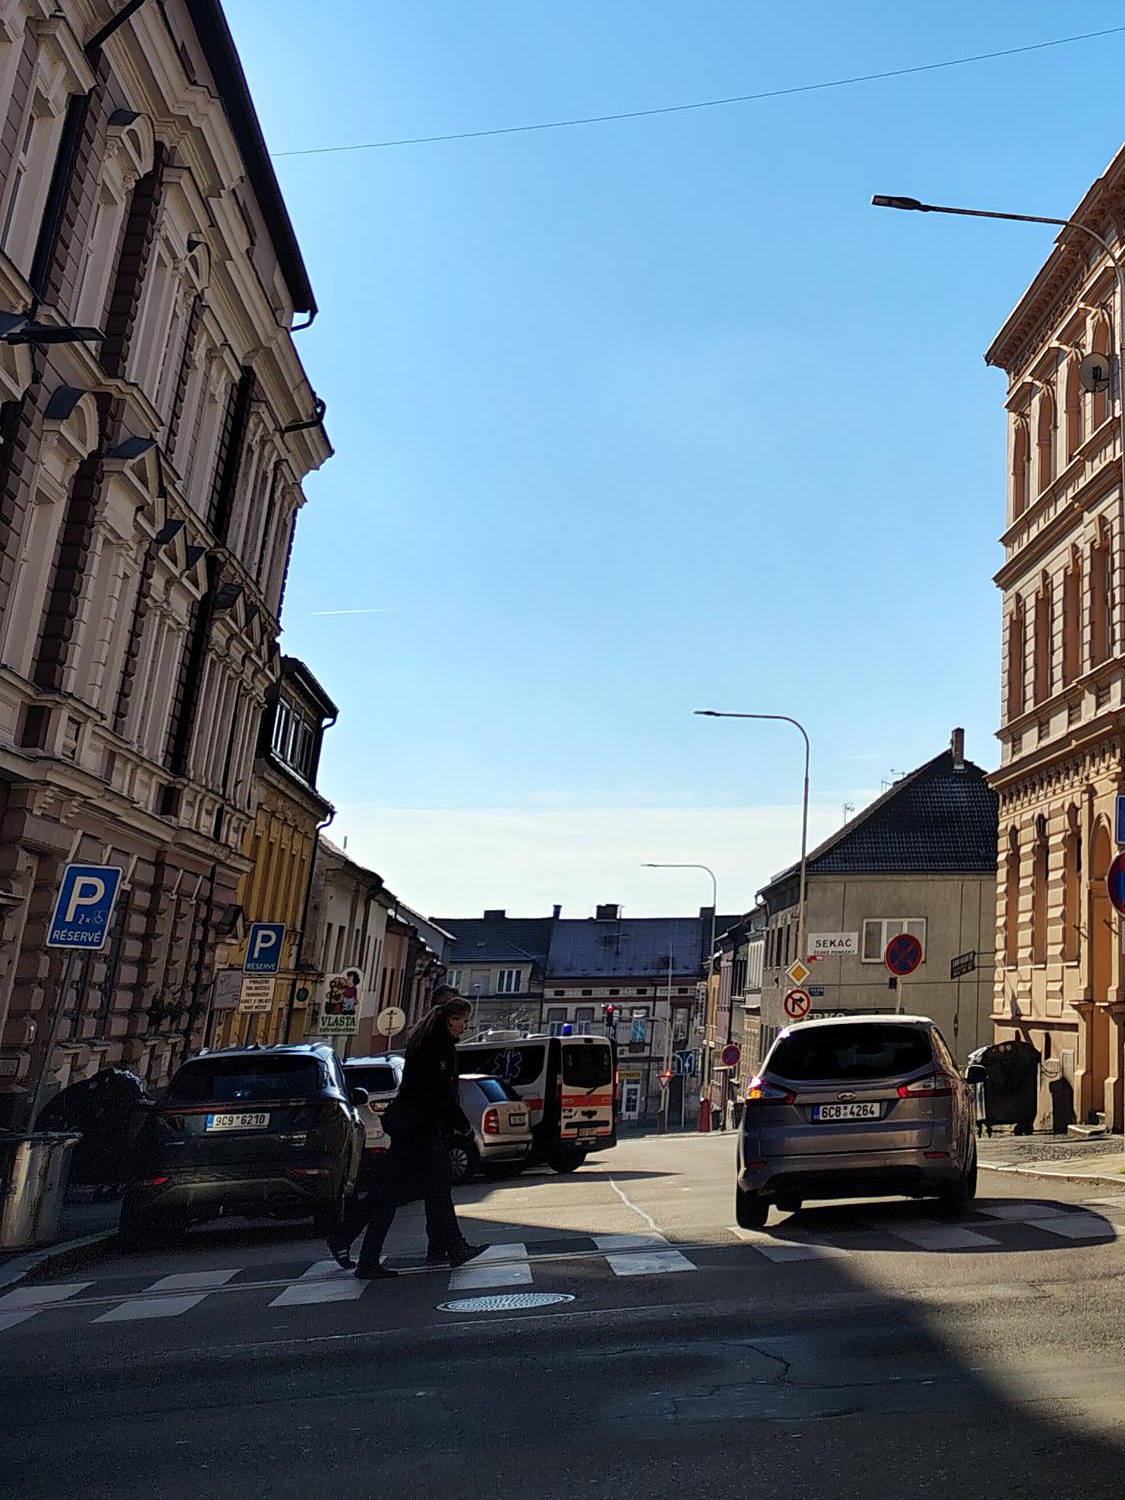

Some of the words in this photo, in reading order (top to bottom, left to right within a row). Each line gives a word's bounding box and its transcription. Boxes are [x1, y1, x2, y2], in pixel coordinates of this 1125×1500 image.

[64, 875, 106, 922] P
[52, 927, 102, 943] RÉSERVÉ
[252, 929, 277, 959] P
[321, 1015, 356, 1027] VLASTA
[821, 1105, 842, 1119] 6C8
[848, 1103, 876, 1117] 4264
[215, 1115, 235, 1127] 9C9
[240, 1113, 266, 1125] 6210
